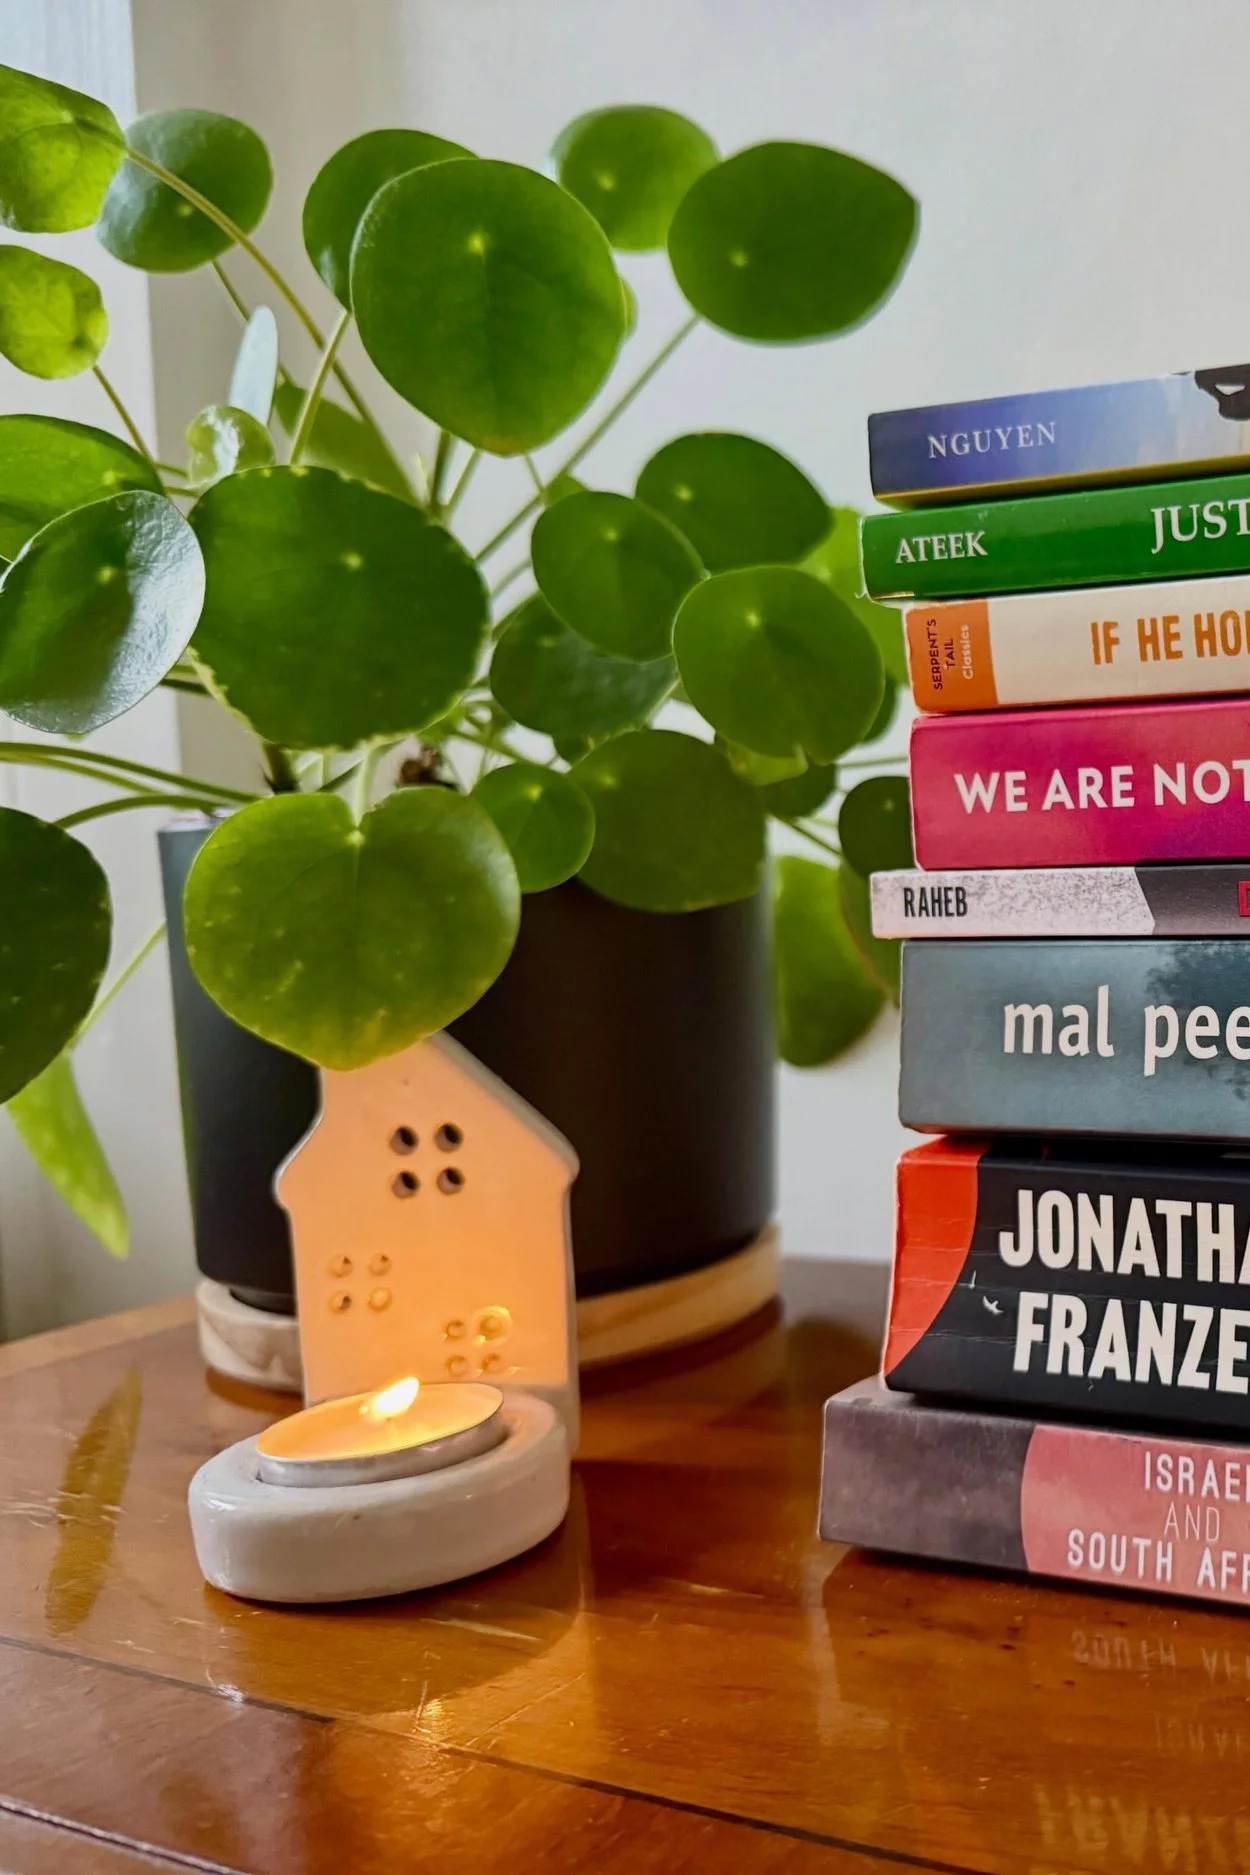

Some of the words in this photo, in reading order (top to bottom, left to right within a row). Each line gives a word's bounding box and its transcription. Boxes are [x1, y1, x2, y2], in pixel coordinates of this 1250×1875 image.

[927, 421, 1057, 459] NGUYEN
[895, 531, 988, 564] ATEEK
[926, 618, 943, 691] SERPENT'S
[944, 638, 956, 670] TAIL
[960, 623, 974, 680] Classics
[1090, 620, 1121, 666] IF
[1136, 613, 1182, 662] HE
[954, 770, 1029, 815] WE
[1041, 764, 1137, 812] ARE
[903, 885, 969, 919] RAHEB
[1003, 984, 1115, 1059] mal
[1164, 1501, 1220, 1542] AND
[1067, 1528, 1173, 1584] SOUTH
